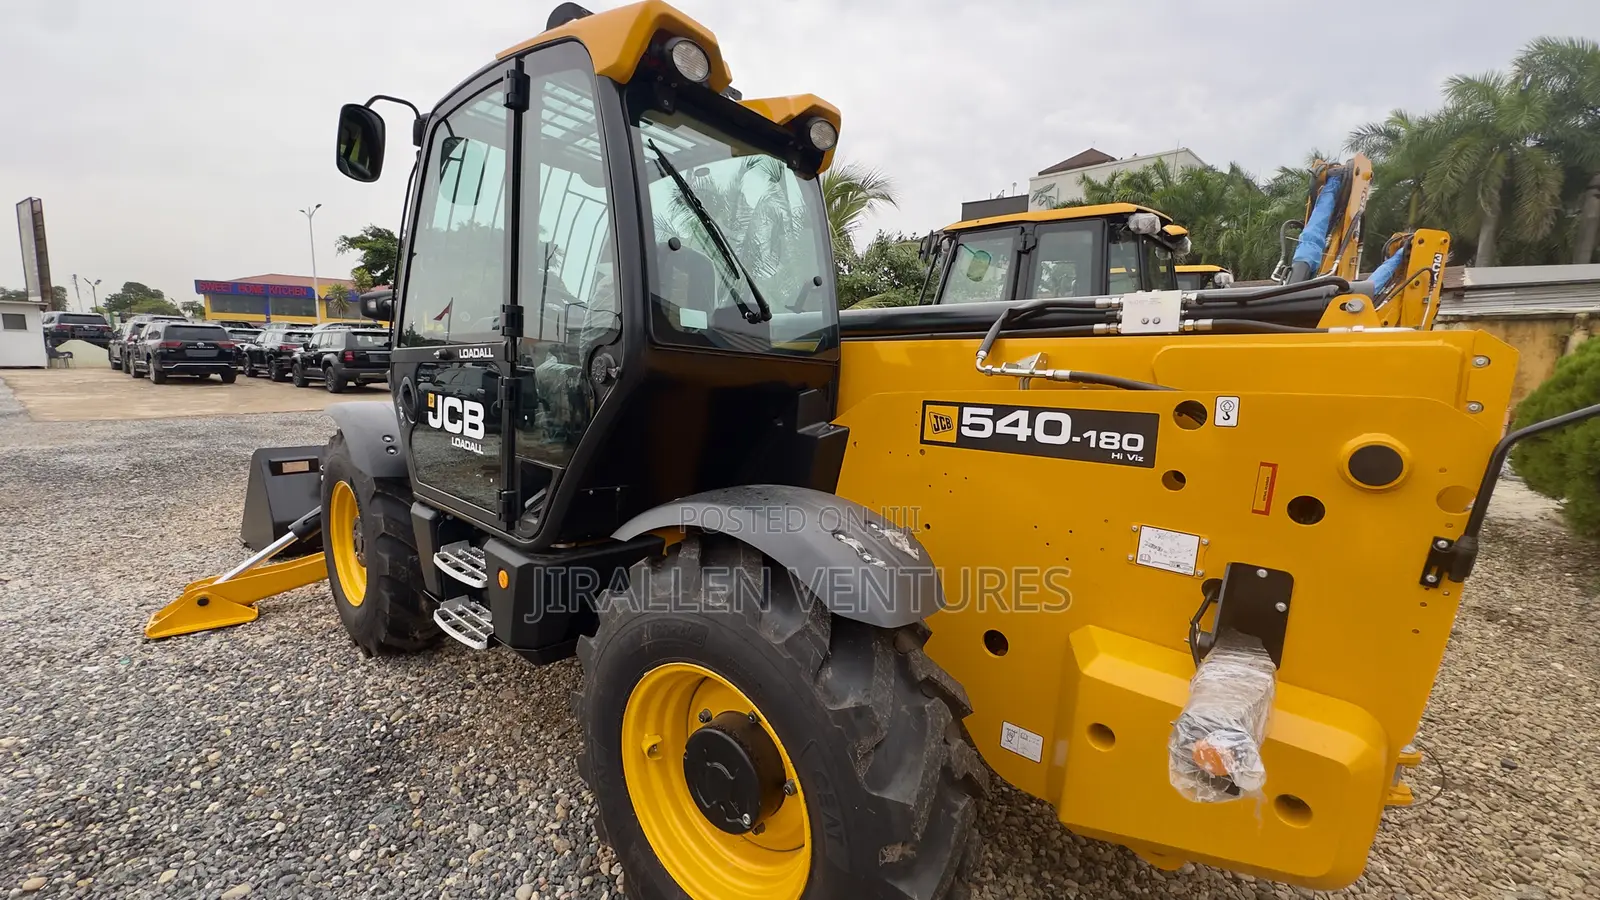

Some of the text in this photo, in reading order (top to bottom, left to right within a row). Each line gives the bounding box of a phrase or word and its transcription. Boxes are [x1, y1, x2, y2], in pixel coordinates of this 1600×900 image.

[199, 282, 307, 296] SWEET HOME KITCHEN
[459, 348, 494, 359] LOADALL
[427, 394, 485, 440] JCB
[931, 413, 953, 432] JCB
[960, 406, 1145, 452] 540-180
[451, 436, 484, 455] LOADALL
[1111, 452, 1144, 462] Hi Viz
